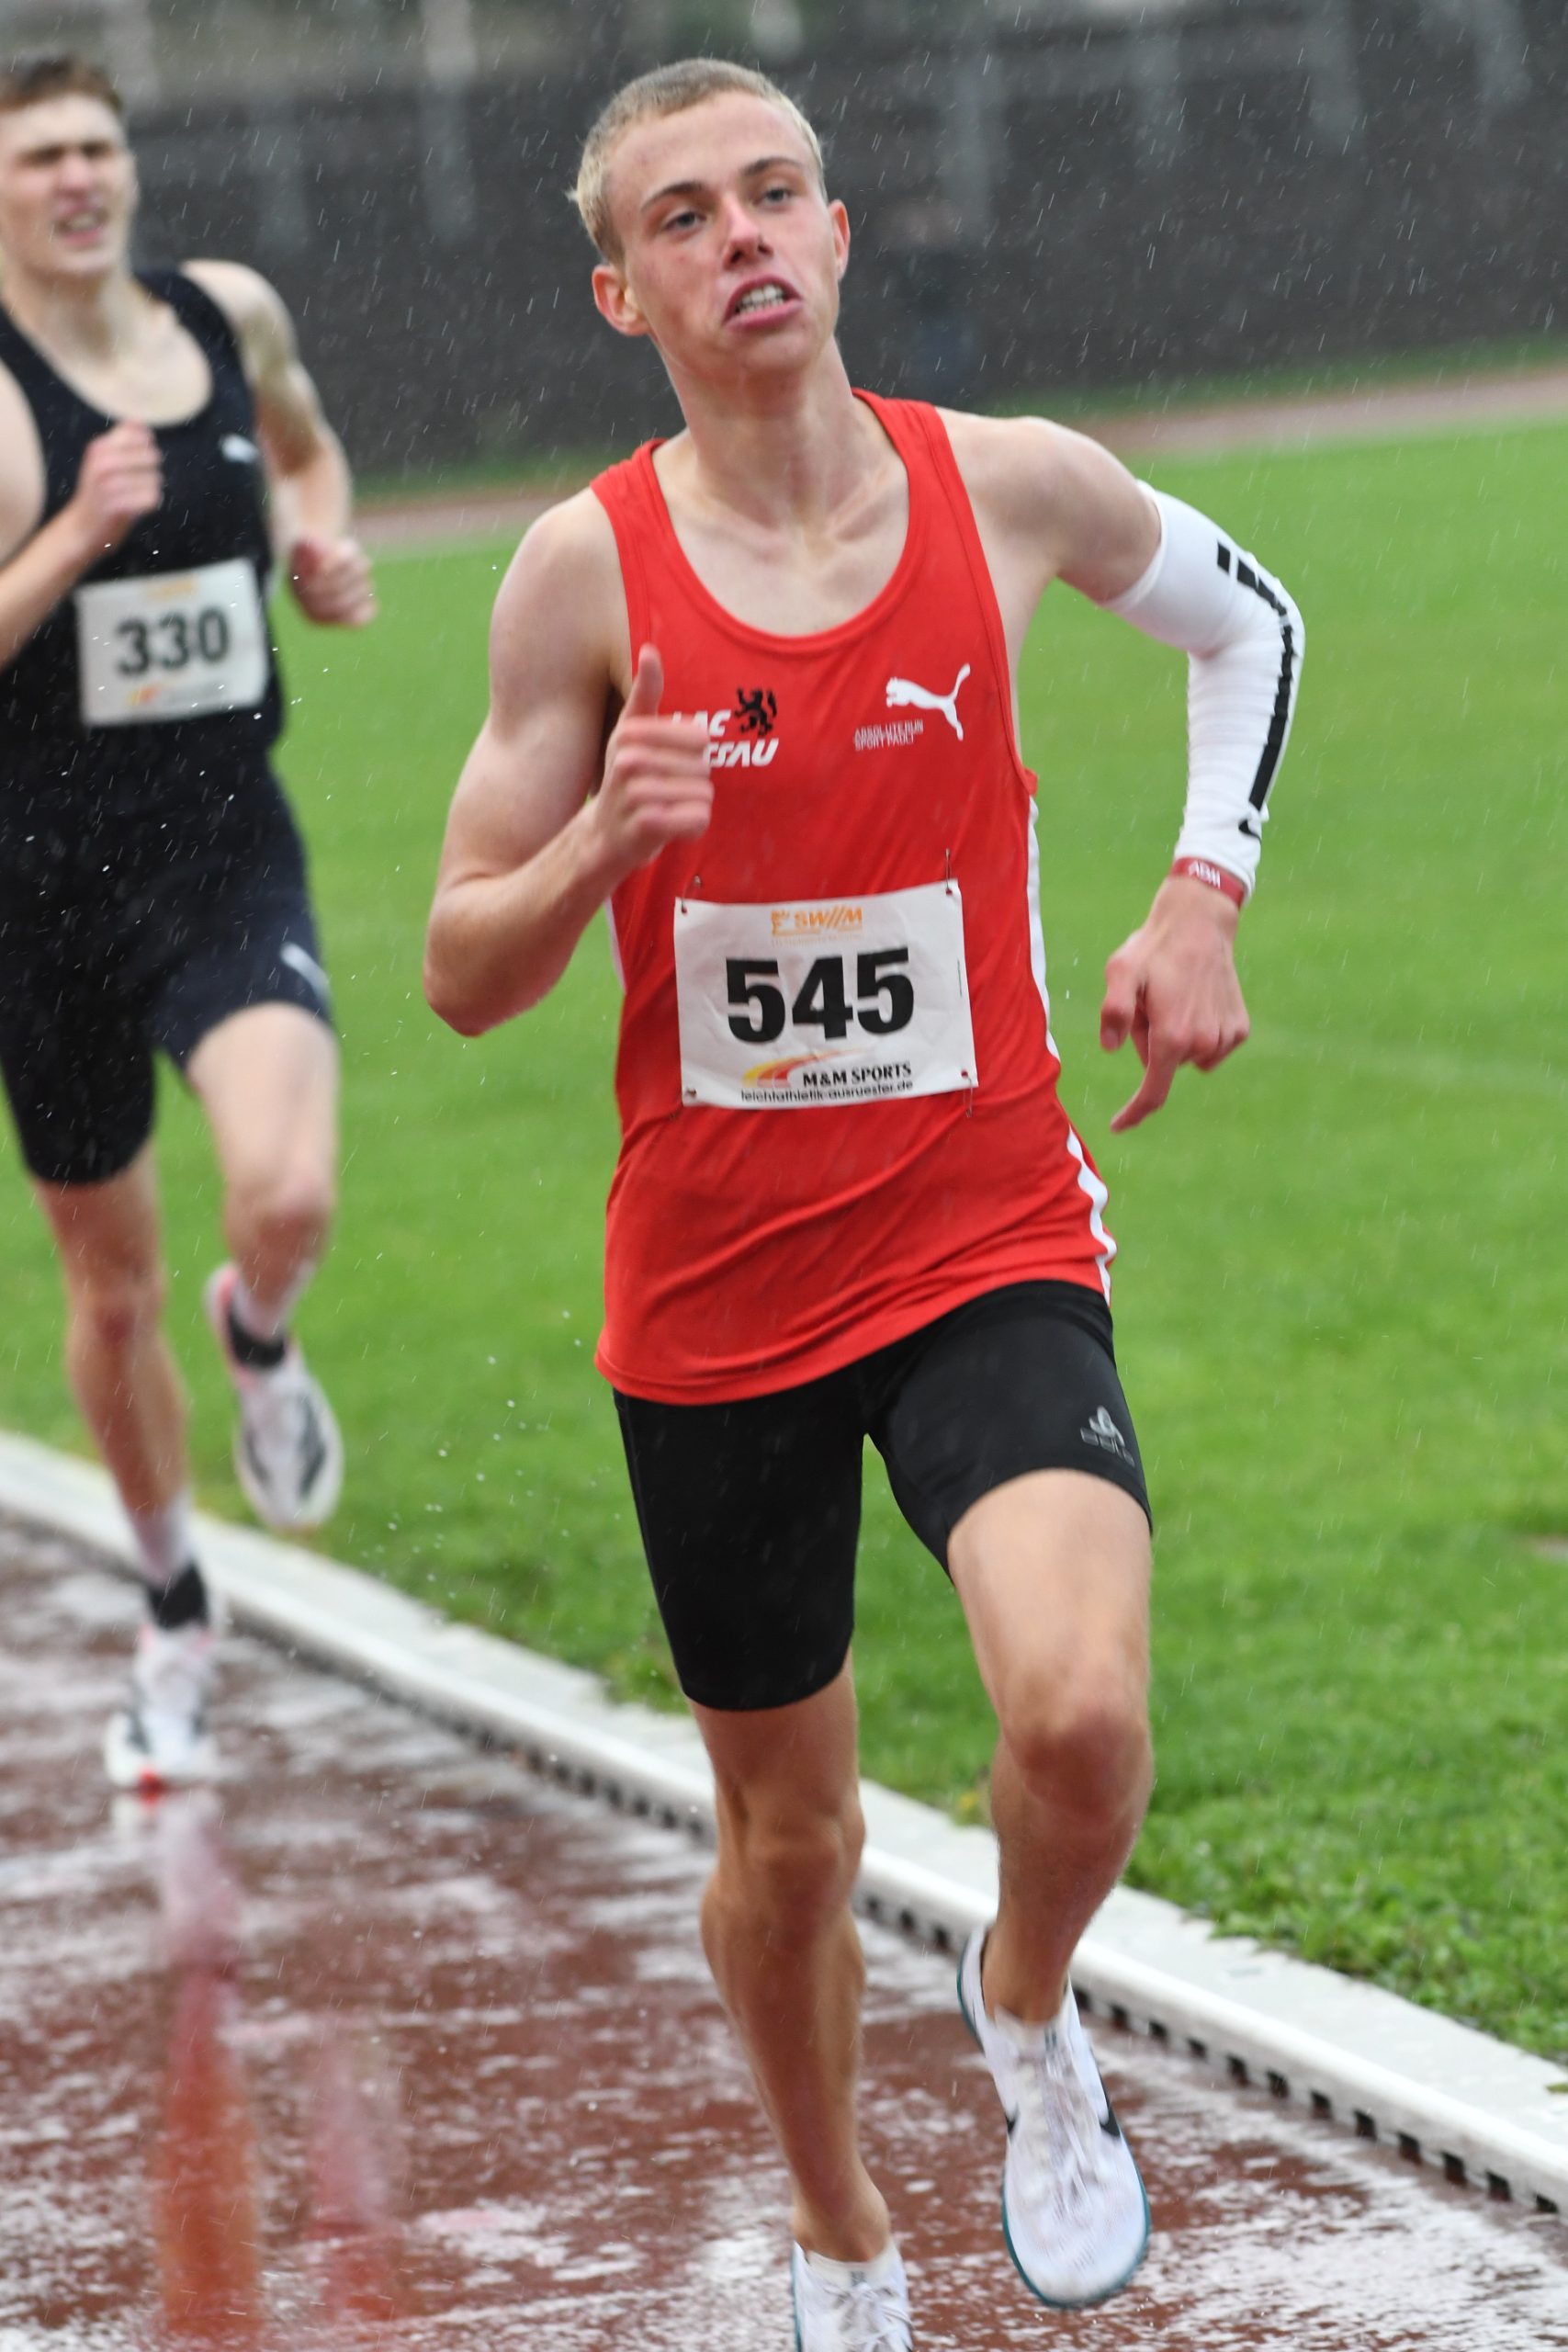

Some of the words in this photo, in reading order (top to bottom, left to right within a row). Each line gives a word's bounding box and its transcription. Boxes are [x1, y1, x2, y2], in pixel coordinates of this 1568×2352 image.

[116, 605, 230, 678] 330
[726, 946, 915, 1044] 545
[802, 1069, 847, 1088] M&M
[851, 1061, 912, 1085] SPORTS
